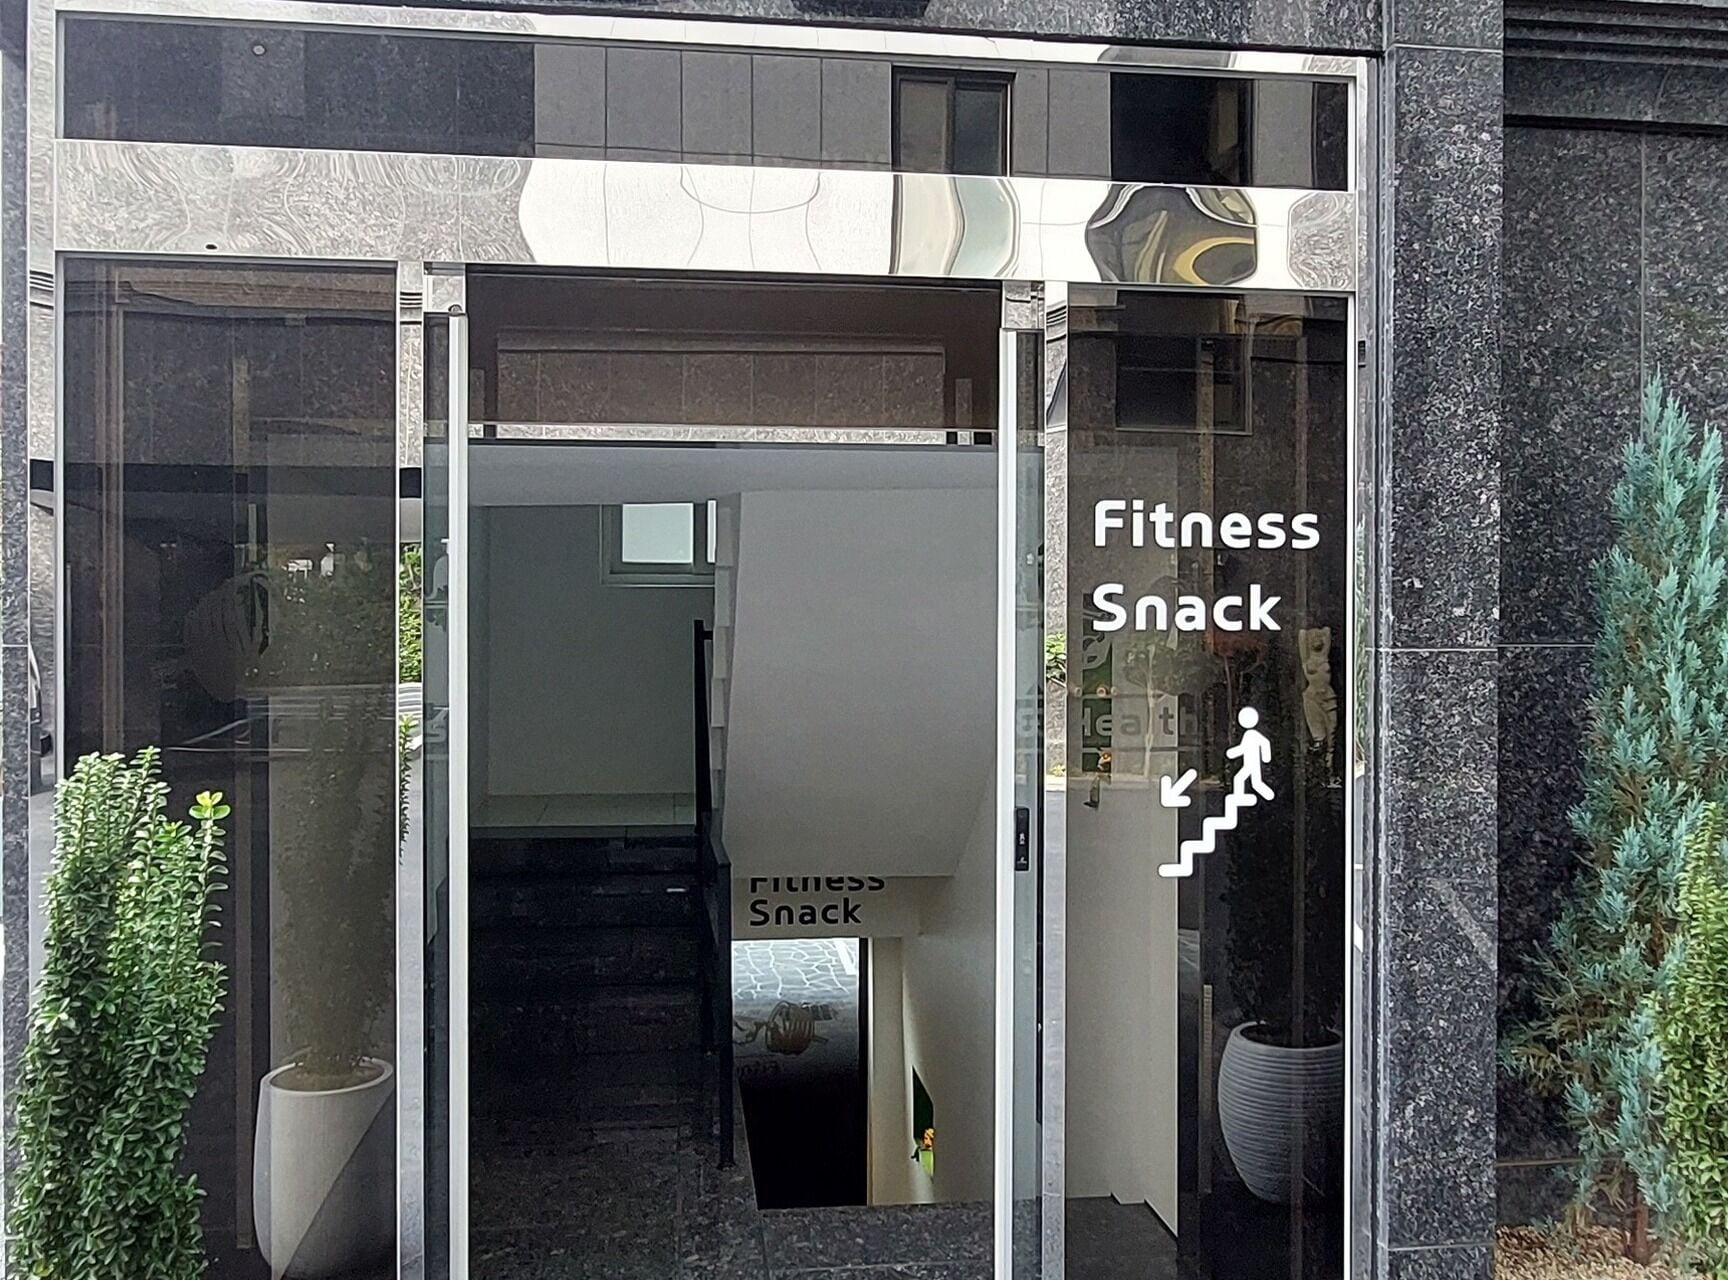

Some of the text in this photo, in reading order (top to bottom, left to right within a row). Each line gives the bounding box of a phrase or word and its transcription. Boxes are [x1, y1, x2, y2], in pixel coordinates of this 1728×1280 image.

[1093, 499, 1320, 550] Fitness
[1092, 583, 1282, 632] Snack
[749, 897, 863, 927] Snack
